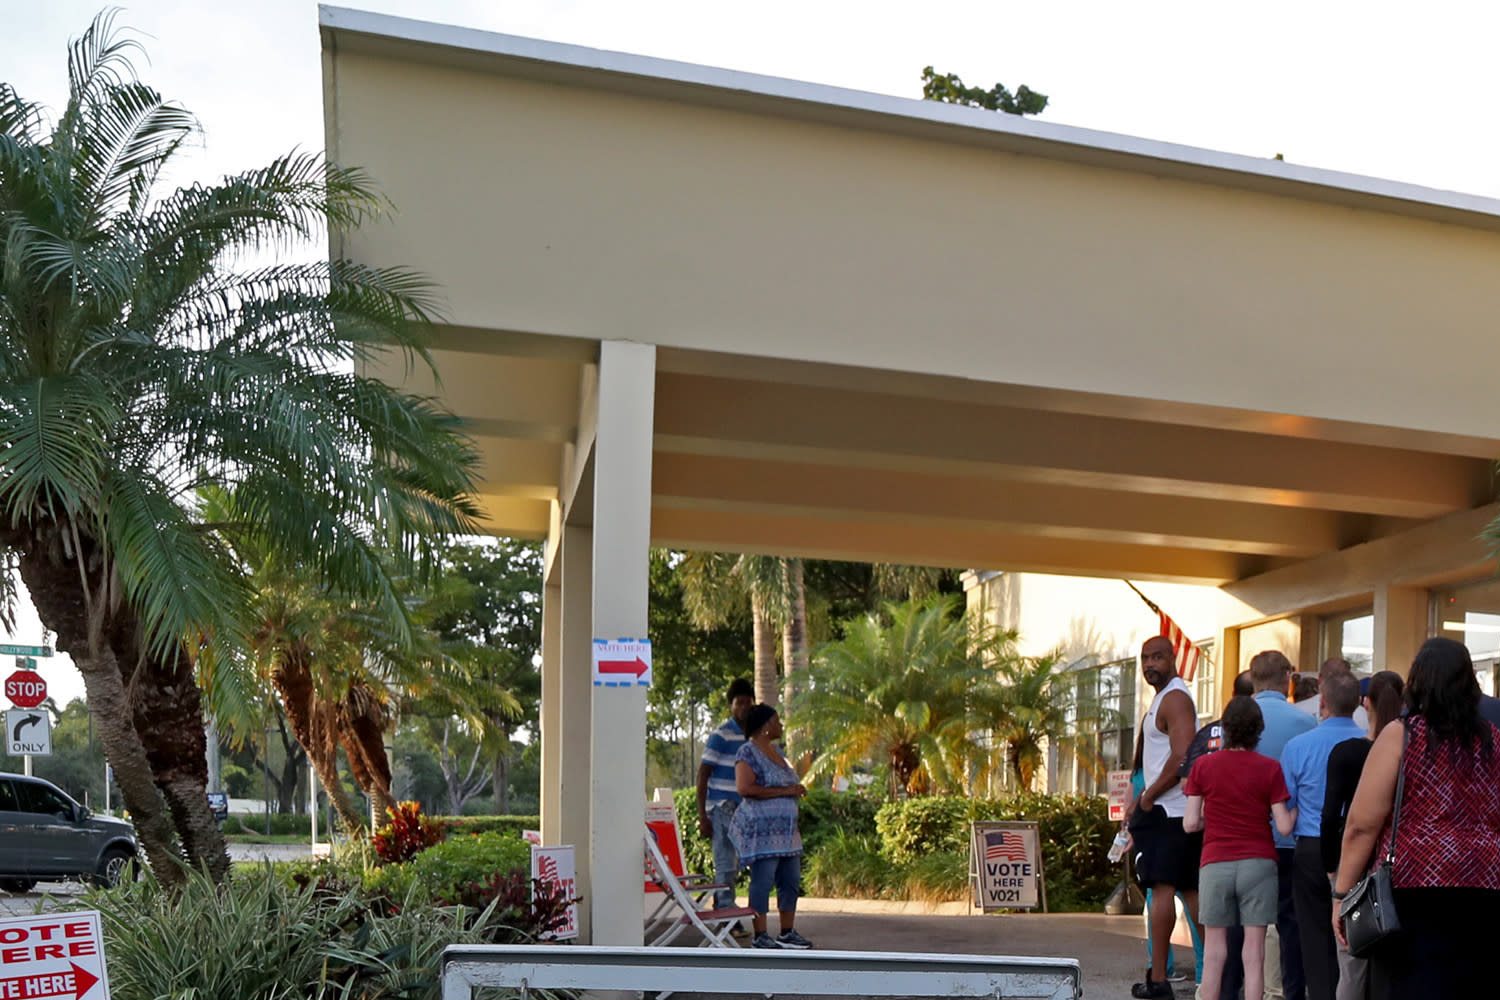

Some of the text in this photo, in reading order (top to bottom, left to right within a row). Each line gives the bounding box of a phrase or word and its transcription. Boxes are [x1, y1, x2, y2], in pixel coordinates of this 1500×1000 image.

[7, 681, 45, 697] STOP
[12, 743, 45, 752] ONLY
[987, 863, 1032, 877] VOTE
[993, 878, 1024, 887] HERE
[0, 922, 92, 944] OTE
[1, 941, 97, 965] ERE
[25, 974, 77, 996] HERE
